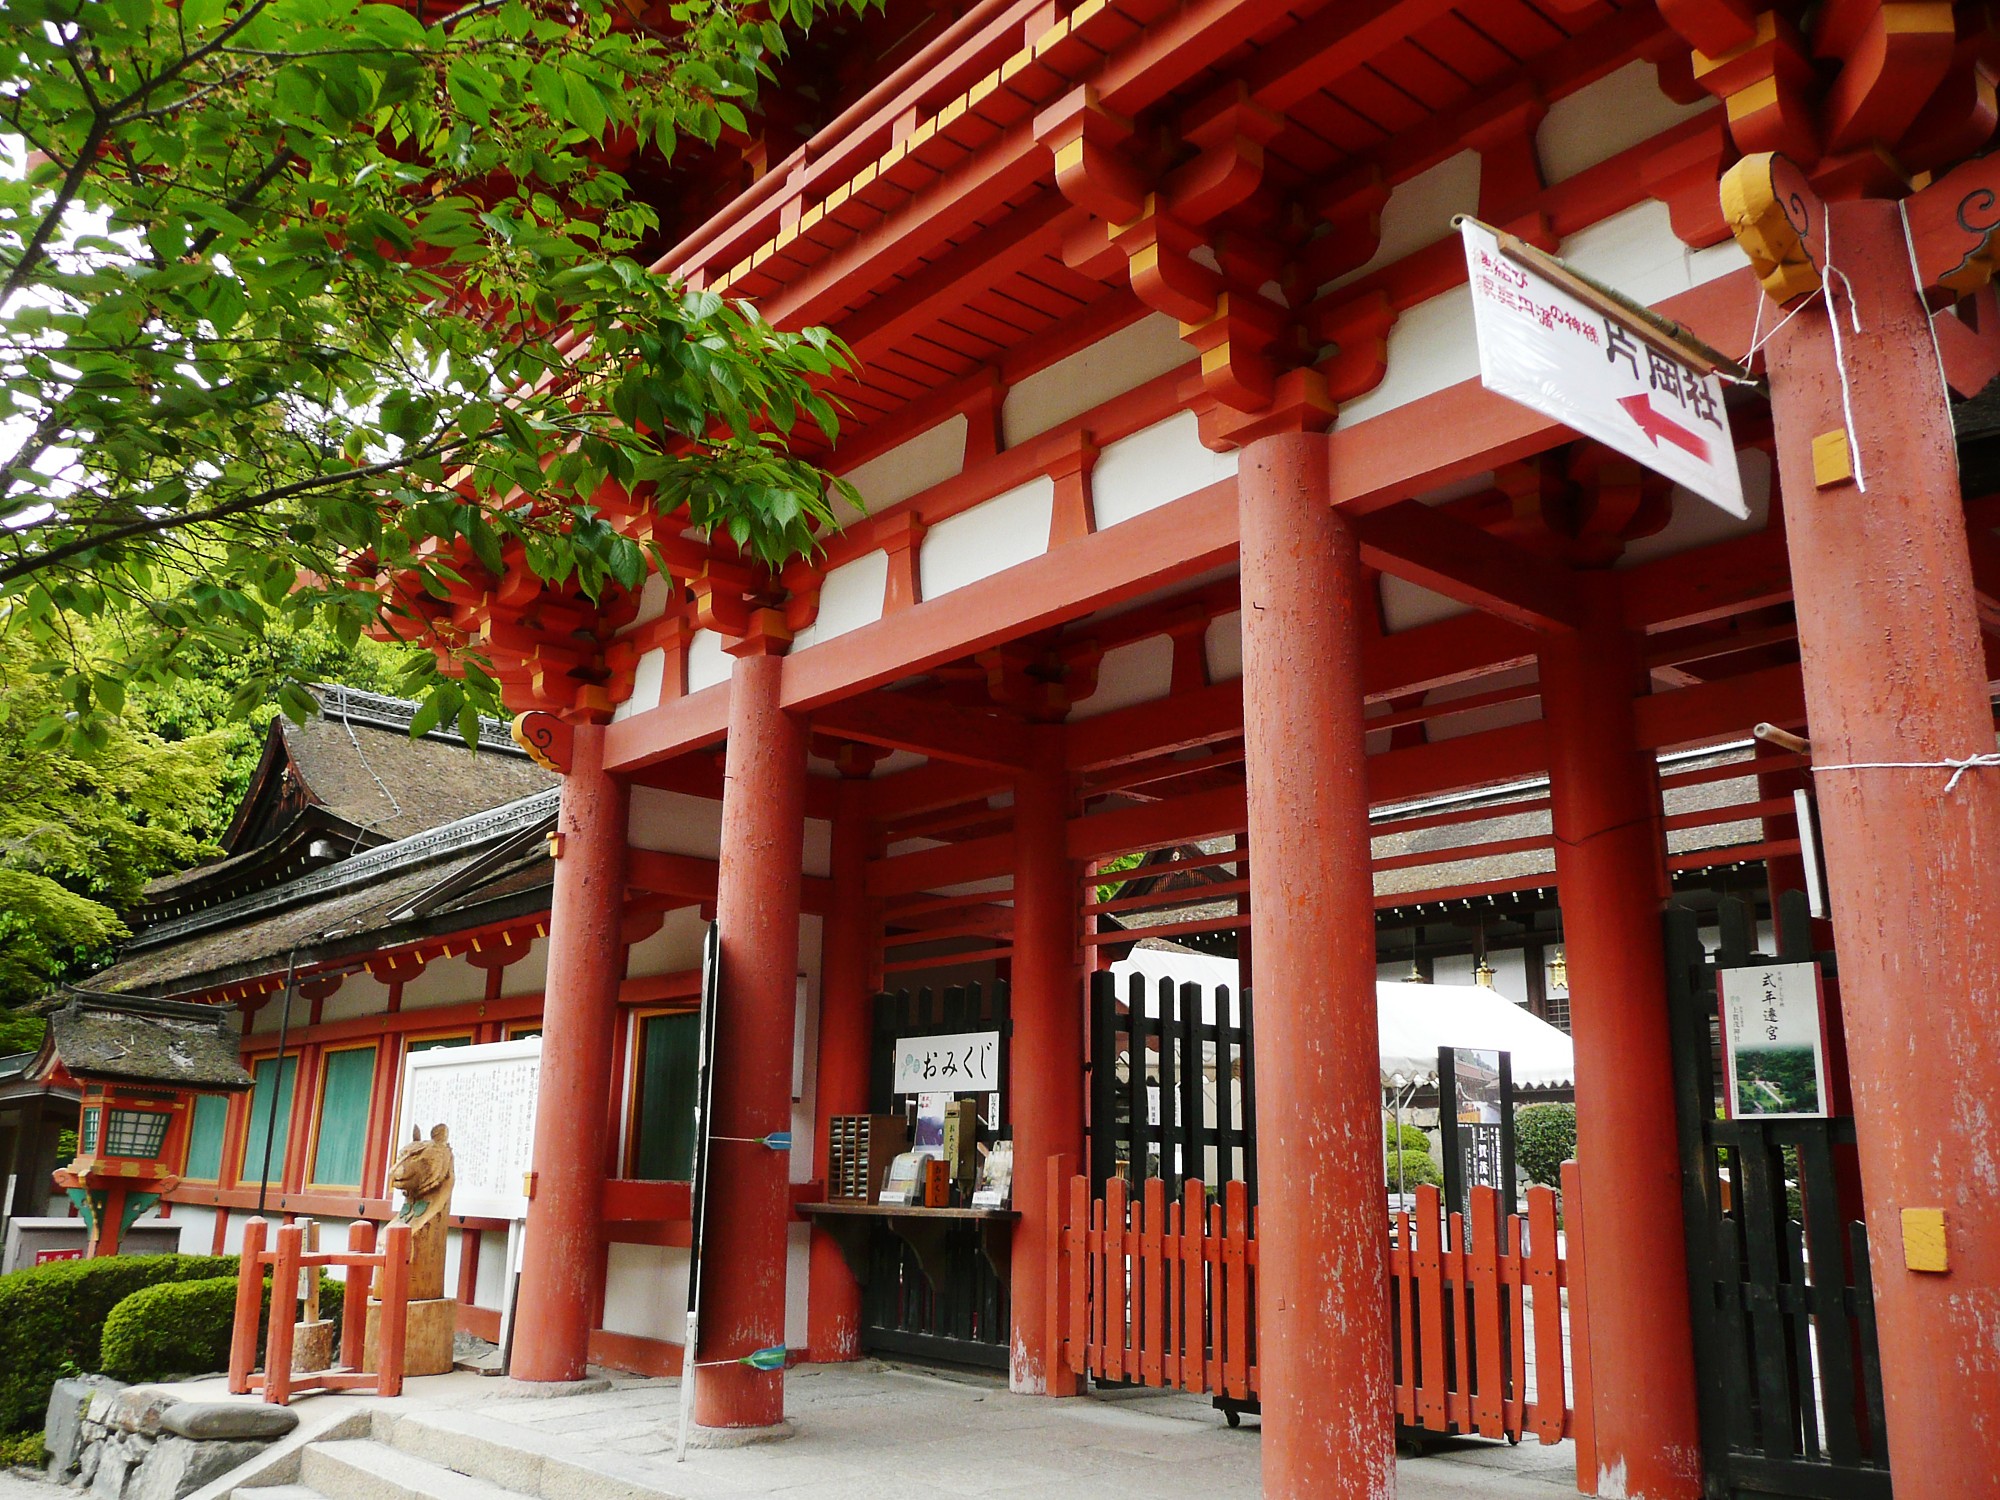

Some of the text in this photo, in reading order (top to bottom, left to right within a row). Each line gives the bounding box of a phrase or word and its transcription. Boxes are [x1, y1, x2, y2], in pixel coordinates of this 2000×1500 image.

[1603, 317, 1723, 431] 片岡社
[1761, 972, 1779, 1041] 式年遷宮
[922, 1041, 993, 1080] おみくじ
